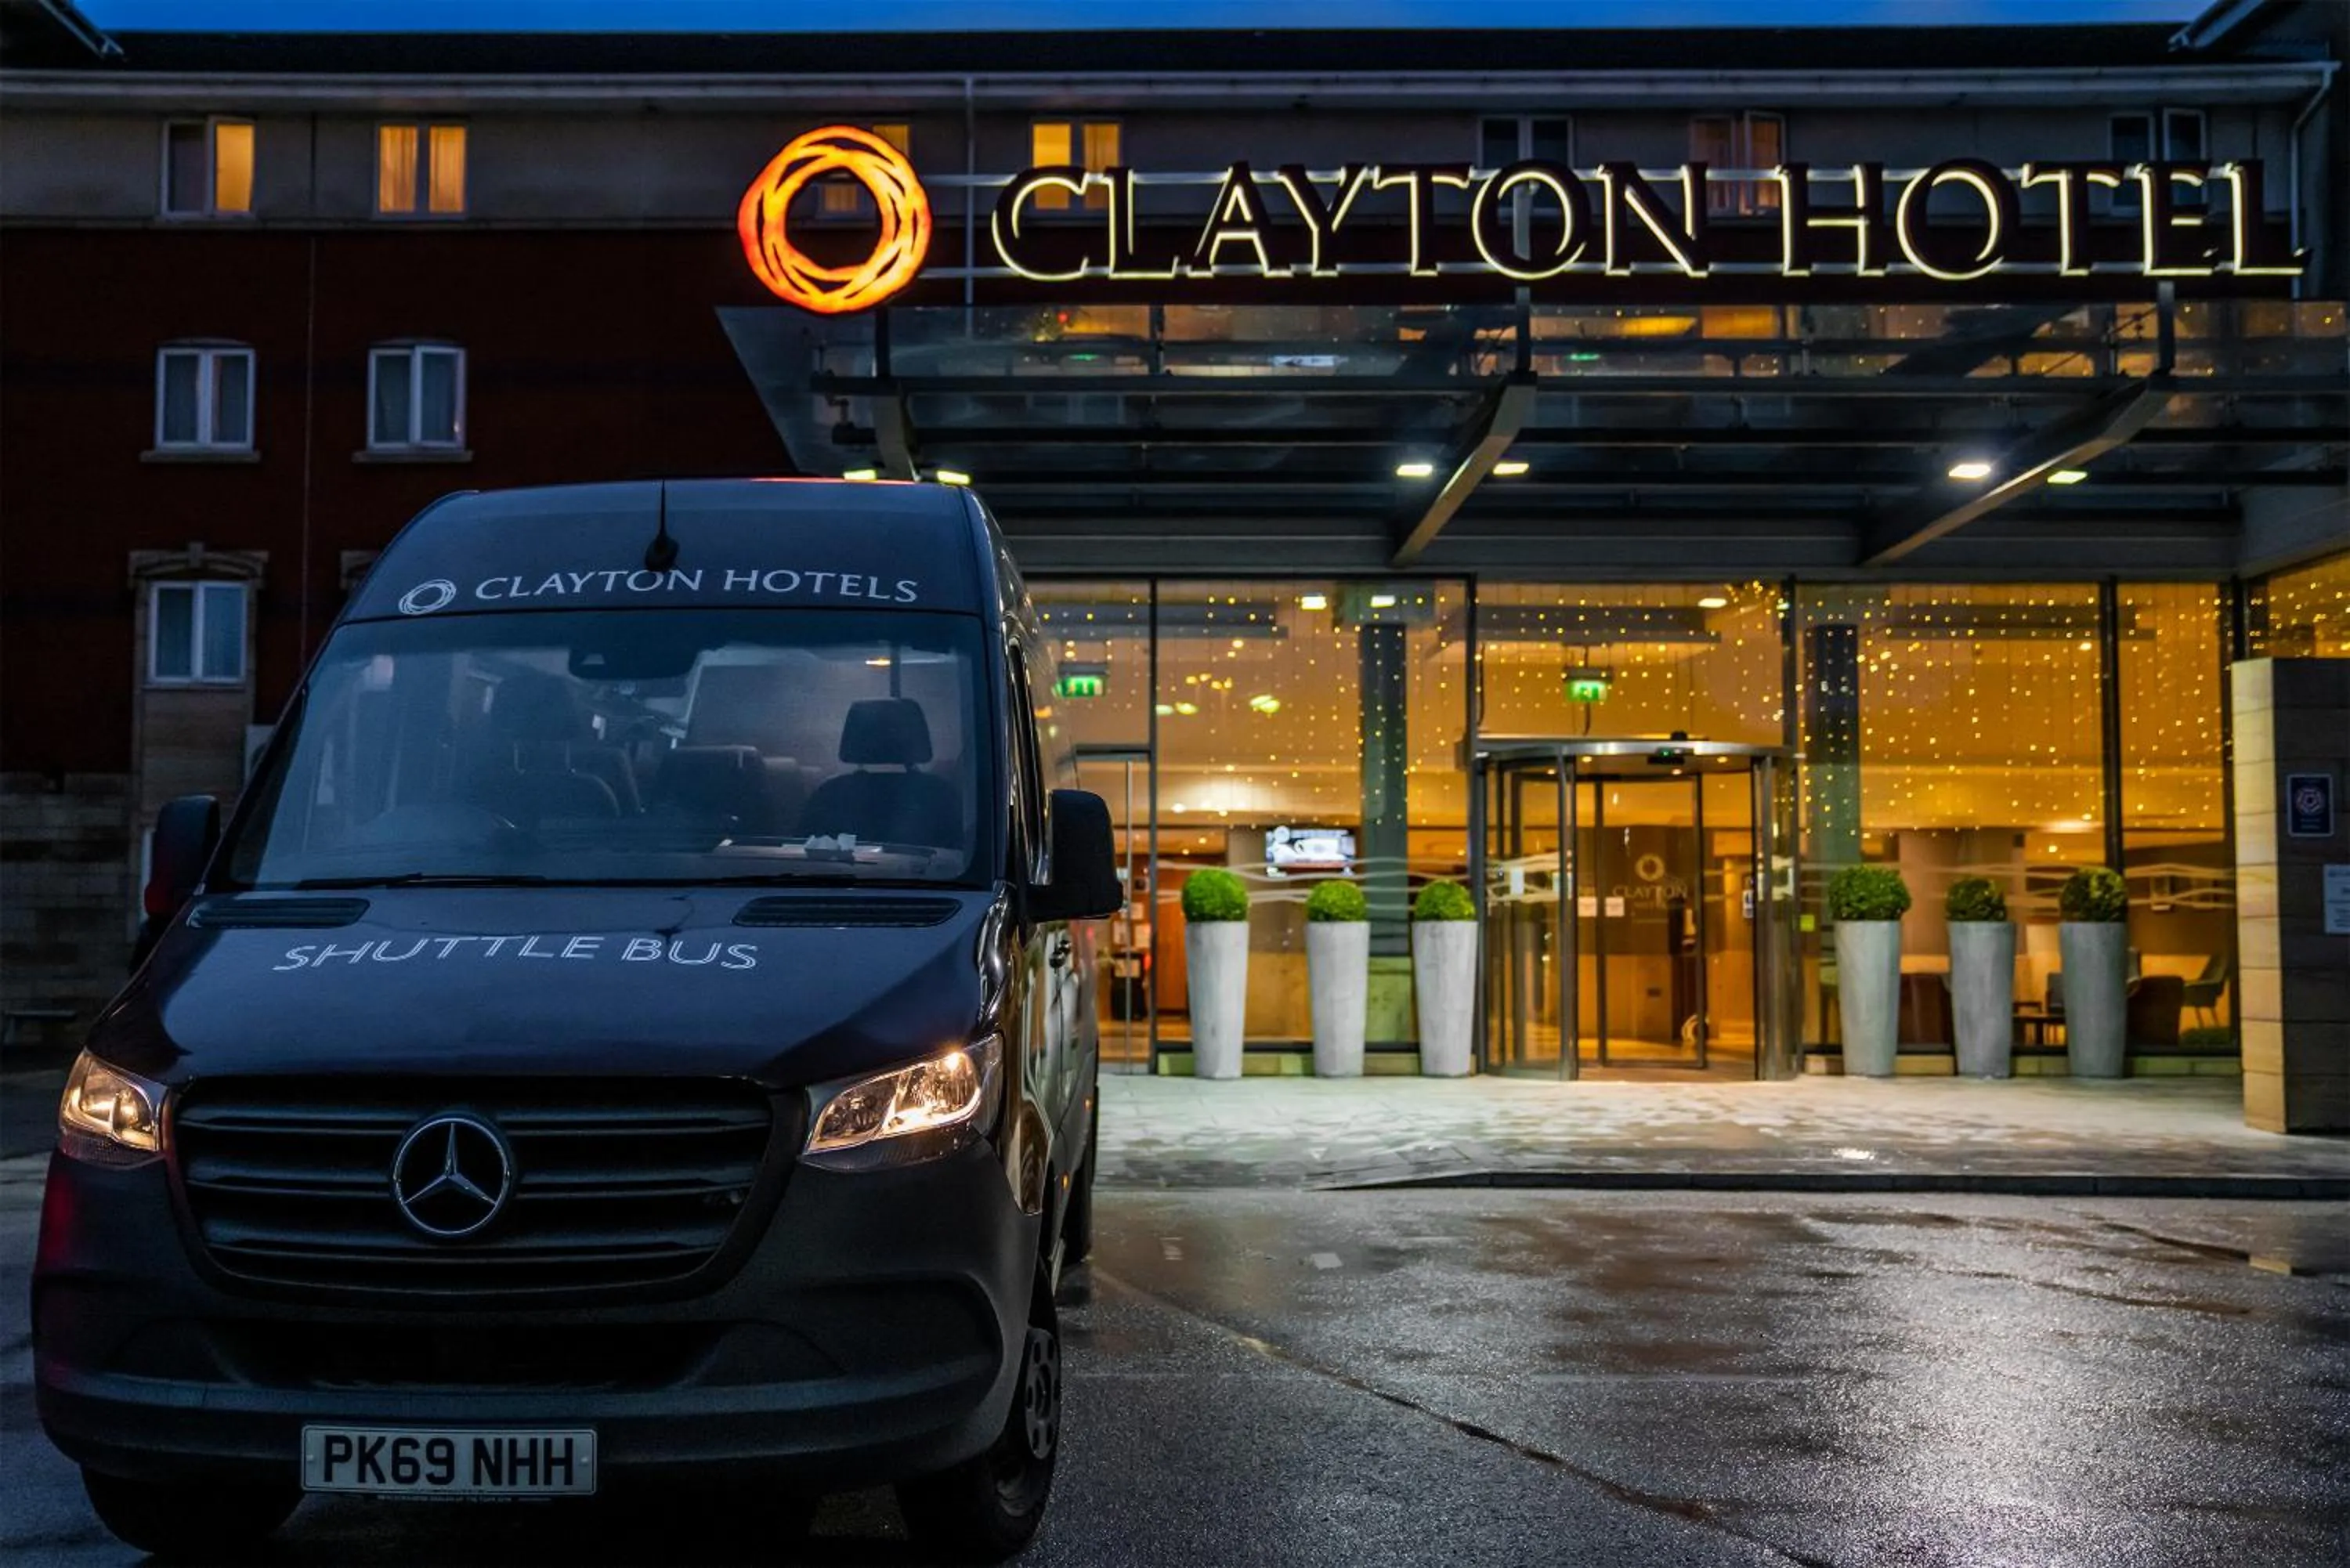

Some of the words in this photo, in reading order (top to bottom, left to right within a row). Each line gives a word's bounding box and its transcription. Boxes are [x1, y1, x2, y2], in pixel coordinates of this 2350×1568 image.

[992, 159, 1711, 281] CLAYTON
[1774, 159, 2312, 280] HOTEL
[475, 569, 703, 599] CLAYTON
[724, 569, 918, 602] HOTELS
[272, 936, 605, 970] SHUTTLE
[620, 938, 758, 970] BUS
[324, 1434, 455, 1486] PK69
[472, 1437, 573, 1486] NHH
